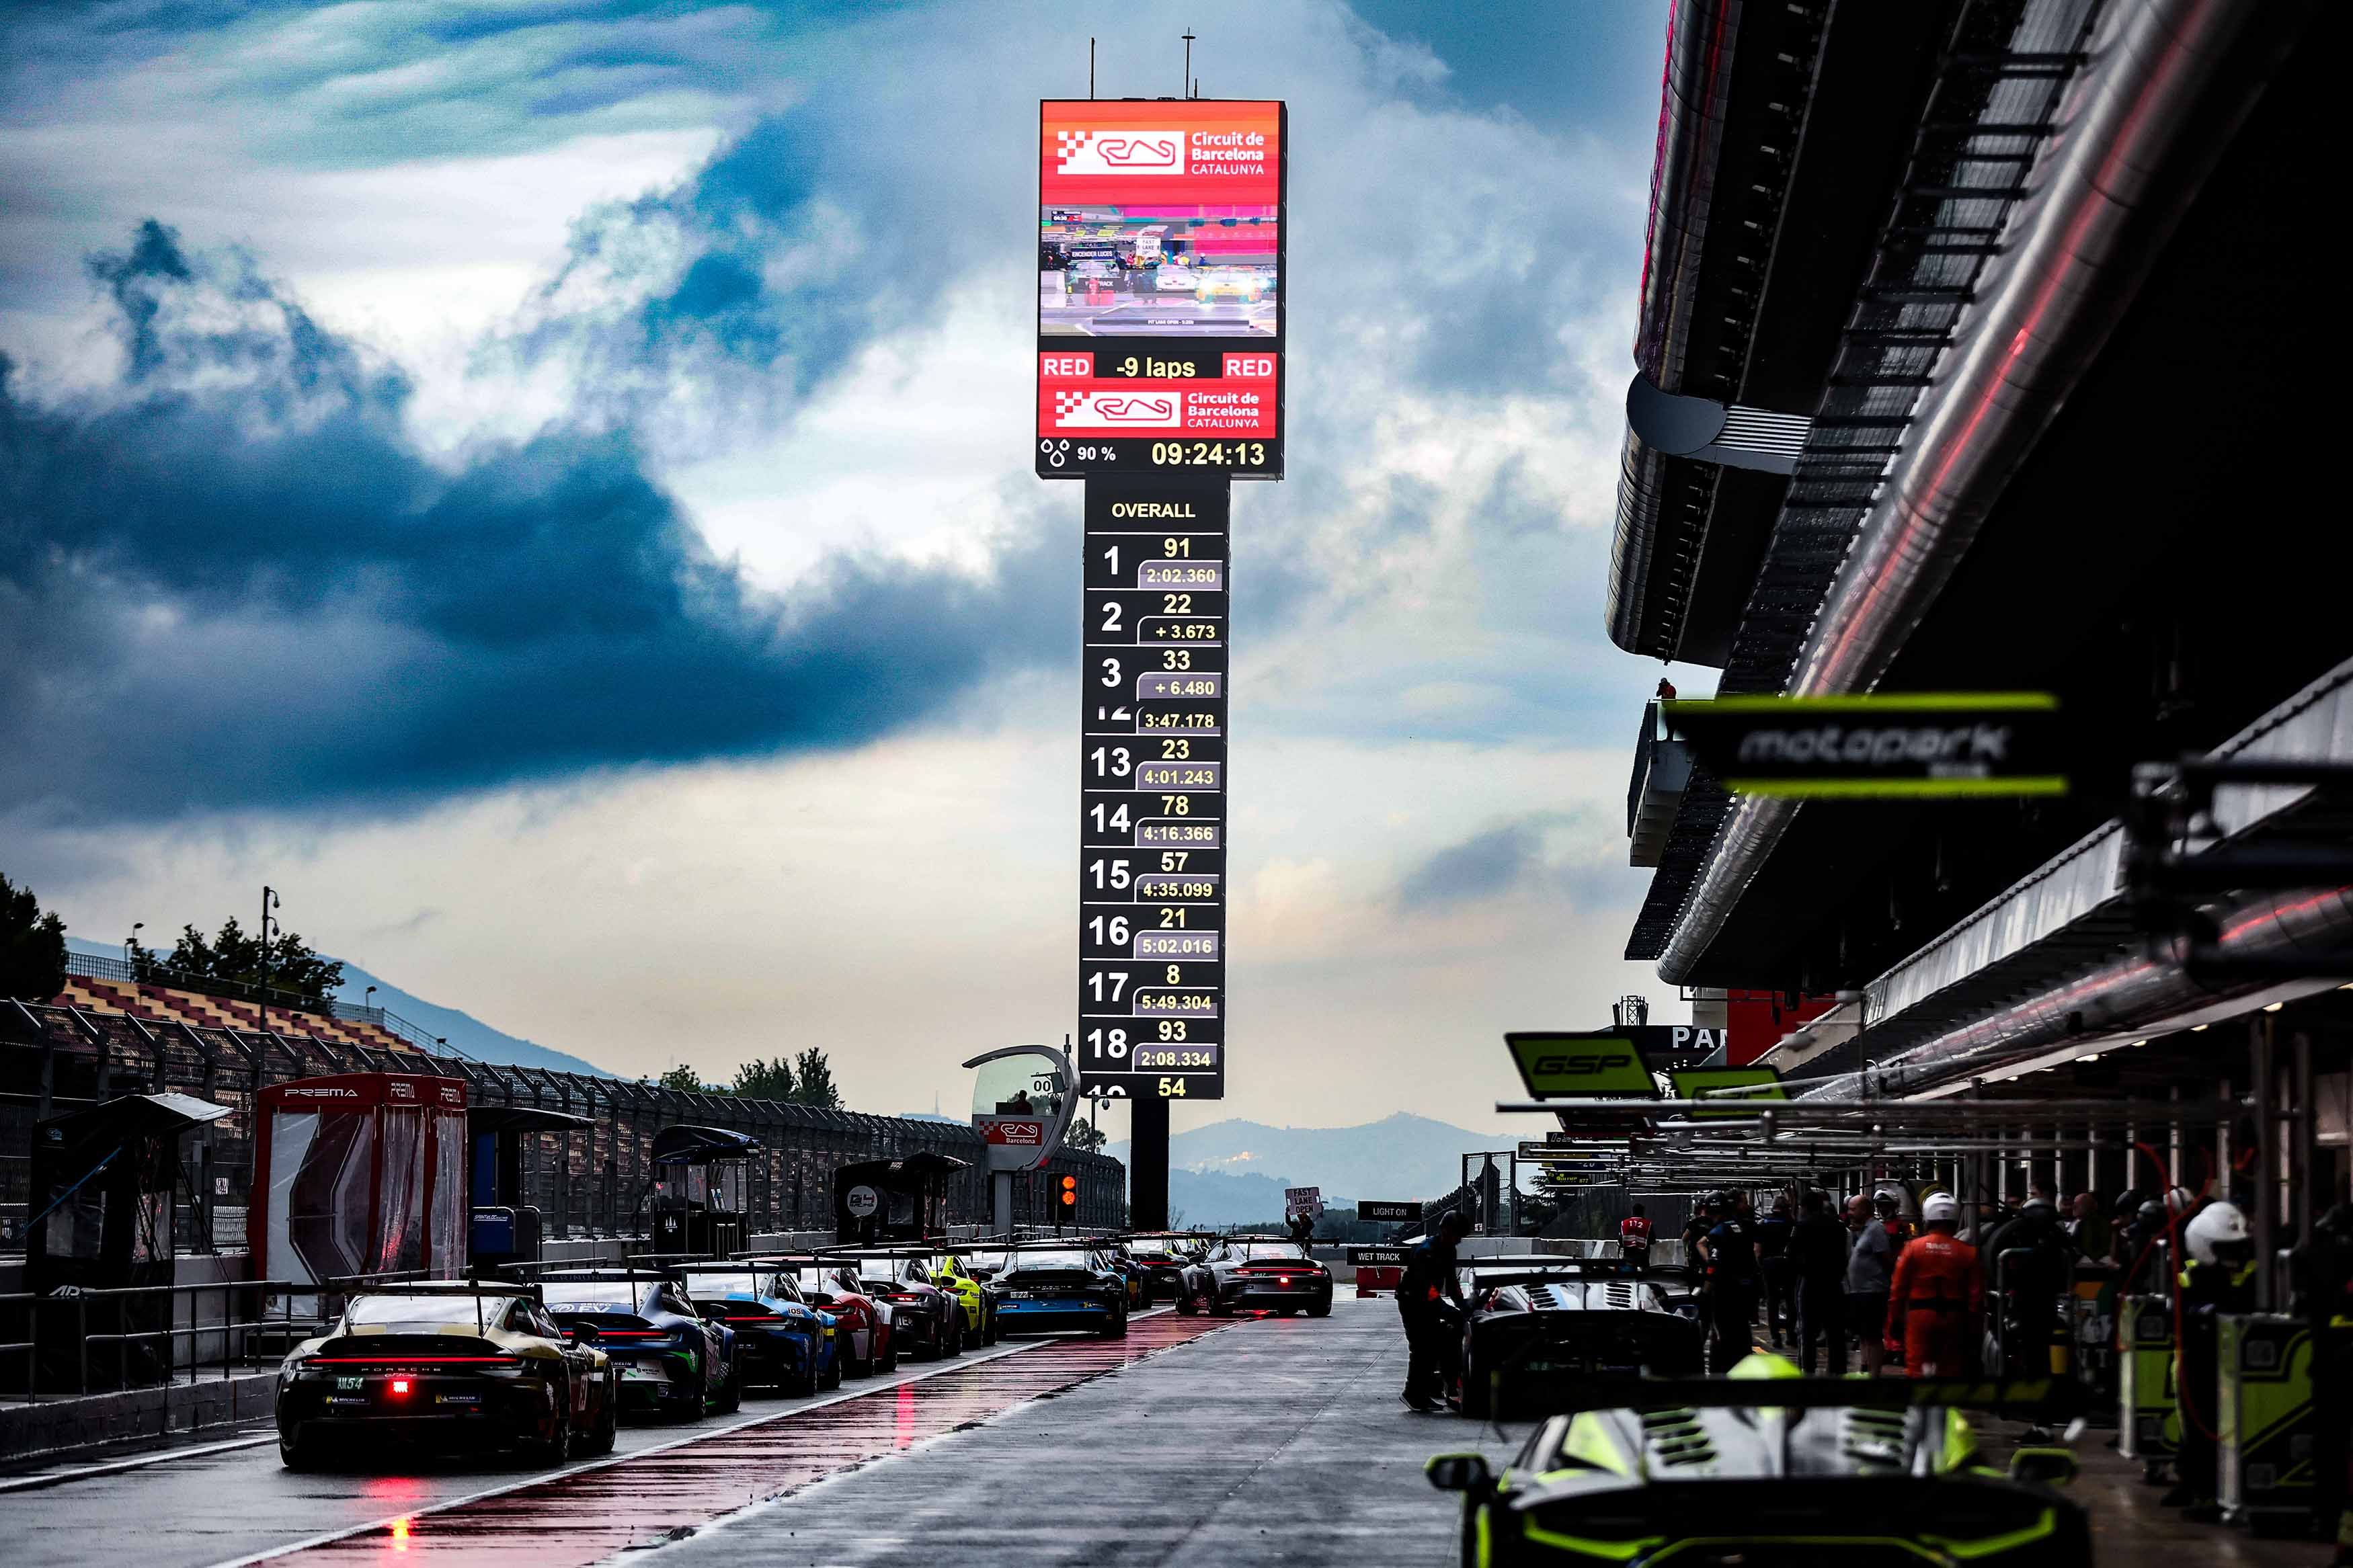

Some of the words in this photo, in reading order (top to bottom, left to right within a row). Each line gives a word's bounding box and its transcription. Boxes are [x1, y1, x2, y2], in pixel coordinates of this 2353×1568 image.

[1191, 132, 1243, 147] Circuit
[1247, 132, 1264, 147] de
[1191, 148, 1265, 161] Barcelona
[1191, 164, 1265, 175] CATALUNYA
[1044, 359, 1089, 375] RED
[1117, 358, 1138, 376] -9
[1146, 358, 1196, 379] laps
[1226, 360, 1272, 376] RED
[1188, 393, 1240, 404] Circuit
[1243, 393, 1259, 404] de
[1188, 406, 1259, 417] Barcelona
[1188, 419, 1259, 427] CATALUNYA
[1078, 447, 1096, 460] 90
[1102, 447, 1116, 461] %
[1152, 443, 1265, 464] 09:24:13
[1112, 503, 1195, 518] OVERALL
[1164, 538, 1189, 558] 91
[1104, 546, 1119, 575] 1
[1147, 569, 1215, 583] 2:02.360
[1163, 594, 1191, 614] 22
[1101, 602, 1122, 631] 2
[1156, 627, 1166, 637] +
[1171, 625, 1215, 638] 3.673
[1162, 650, 1191, 670] 33
[1101, 658, 1121, 688] 3
[1155, 683, 1166, 693] +
[1170, 681, 1215, 695] 6.480
[1145, 714, 1214, 728] 3:47.178
[1162, 739, 1190, 759] 23
[1739, 725, 2006, 764] motopark
[1091, 747, 1131, 777] 13
[1144, 770, 1214, 784] 4:01.243
[1162, 796, 1189, 815] 78
[1090, 803, 1131, 833] 14
[1144, 827, 1213, 840] 4:16.366
[1160, 852, 1189, 872] 57
[1089, 859, 1130, 889] 15
[1143, 882, 1213, 897] 4:35.099
[1160, 908, 1185, 928] 21
[1088, 915, 1129, 946] 16
[1142, 940, 1212, 953] 5:02.016
[1166, 964, 1181, 985] 8
[1088, 972, 1129, 1002] 17
[1142, 995, 1211, 1010] 5:49.304
[1158, 1021, 1187, 1041] 93
[1087, 1028, 1127, 1059] 18
[1141, 1052, 1211, 1067] 2:08.334
[1536, 1055, 1631, 1073] GSP
[284, 1089, 358, 1097] PREMA
[391, 1082, 415, 1098] PREMA
[1034, 1081, 1051, 1091] 00
[1158, 1077, 1186, 1096] 54
[440, 1087, 461, 1103] PREMA
[1293, 1188, 1311, 1197] FAST
[1295, 1196, 1312, 1204] LANE
[1296, 1205, 1314, 1213] OPEN
[1372, 1207, 1394, 1216] LIGHT
[1358, 1252, 1376, 1261] WET
[1377, 1252, 1400, 1261] TRACK
